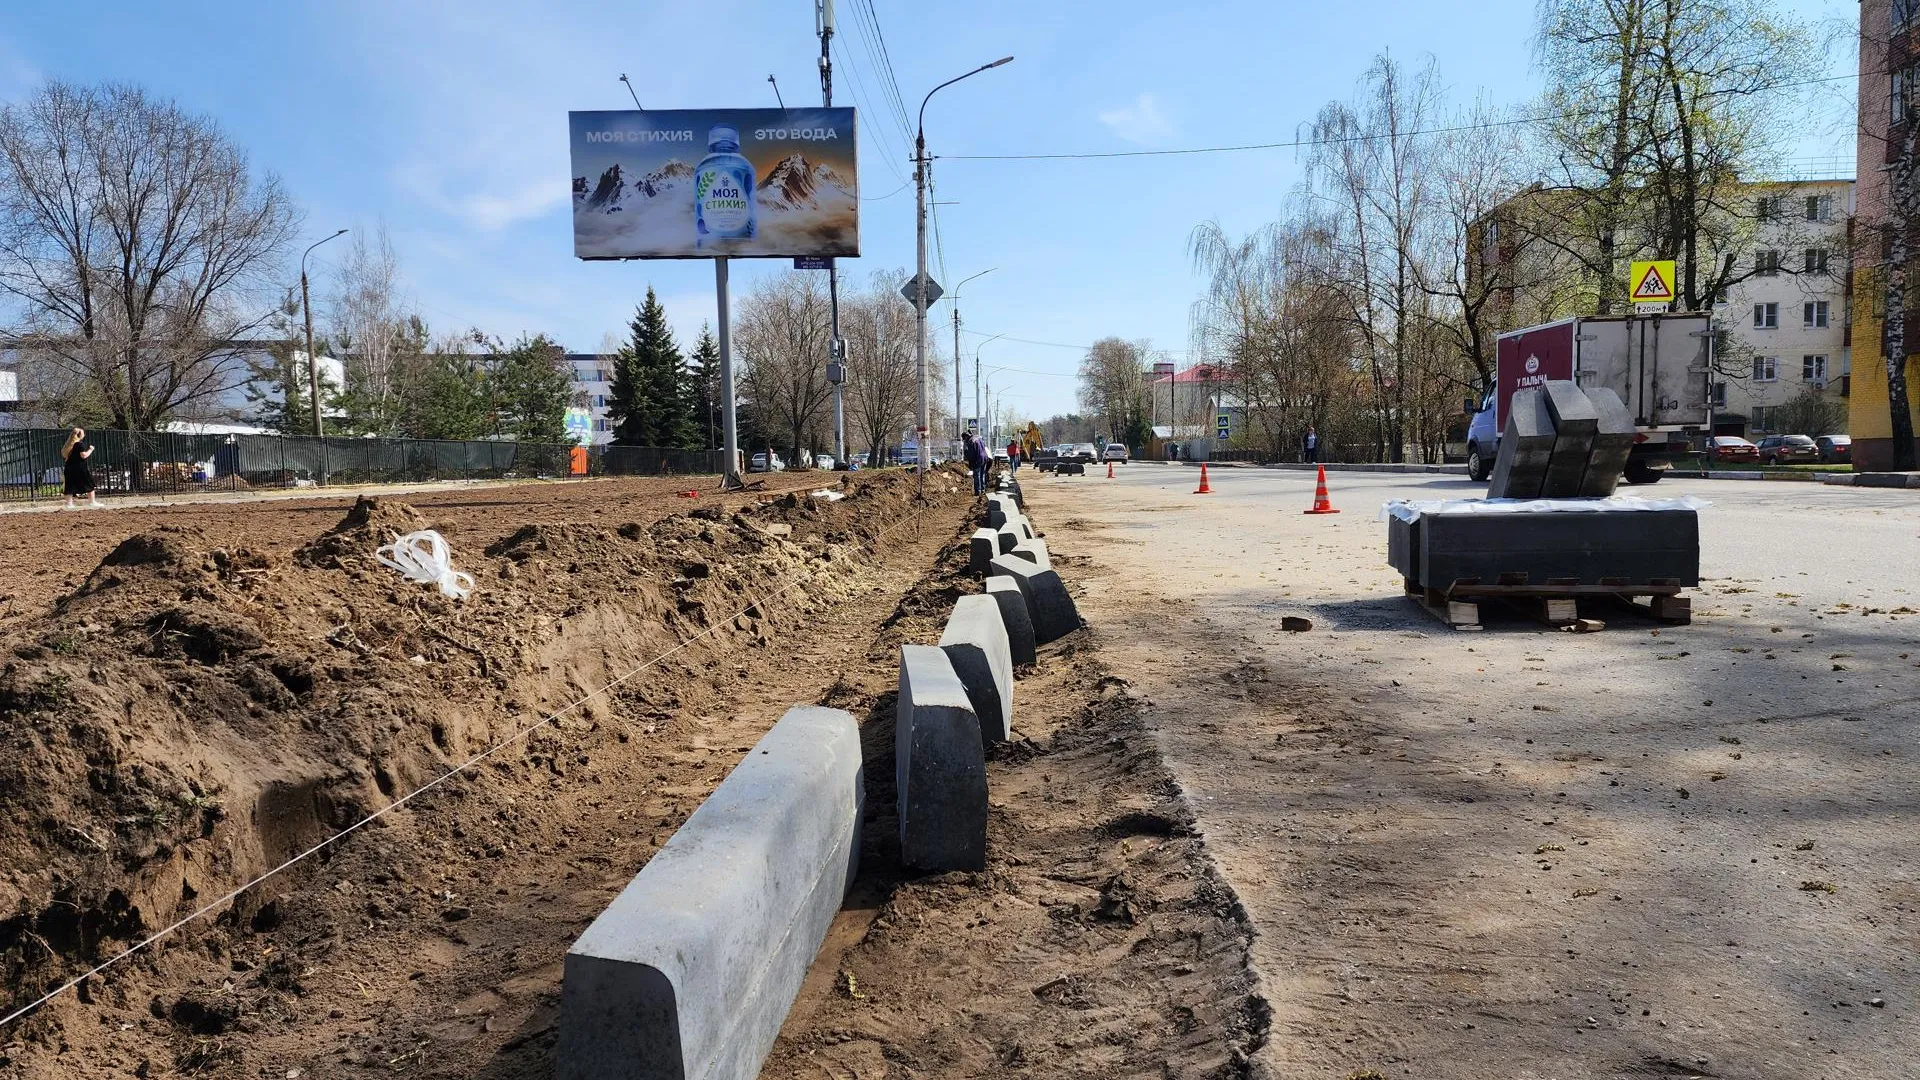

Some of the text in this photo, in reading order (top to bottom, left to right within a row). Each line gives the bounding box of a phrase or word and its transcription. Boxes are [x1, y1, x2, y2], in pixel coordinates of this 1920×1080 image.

[586, 130, 694, 143] МОЯ СТИХИЯ
[754, 127, 838, 141] ЭТО ВОДА
[712, 188, 739, 198] МОЯ
[705, 200, 747, 209] СТИХИЯ
[1516, 373, 1548, 388] У ПАЛЫЧА
